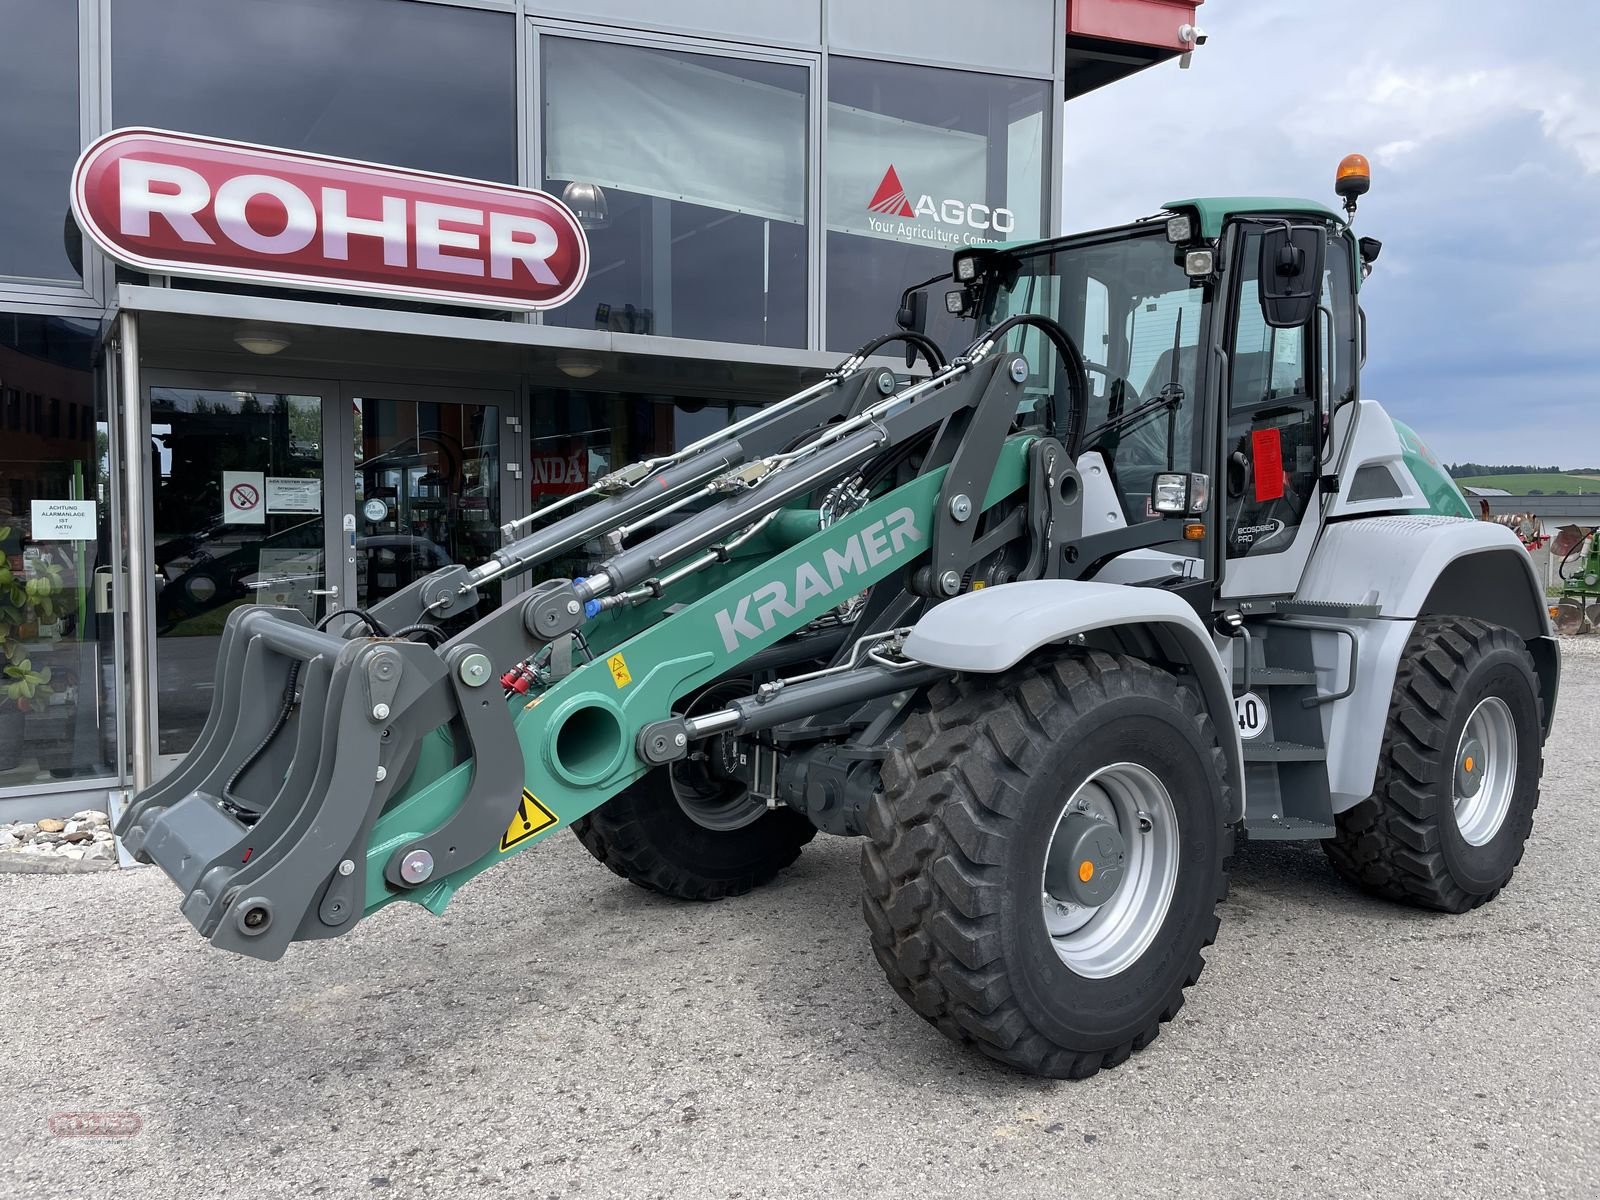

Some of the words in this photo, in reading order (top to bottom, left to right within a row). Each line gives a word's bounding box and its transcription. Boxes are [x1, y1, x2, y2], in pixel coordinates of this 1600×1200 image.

[118, 157, 562, 287] ROHER
[914, 194, 1015, 233] AGCO
[868, 216, 895, 234] Your
[897, 221, 960, 244] Agriculture
[531, 455, 585, 484] NDA
[1237, 522, 1275, 535] ecospeed
[1237, 534, 1253, 544] PRO
[714, 507, 924, 654] KRAMER
